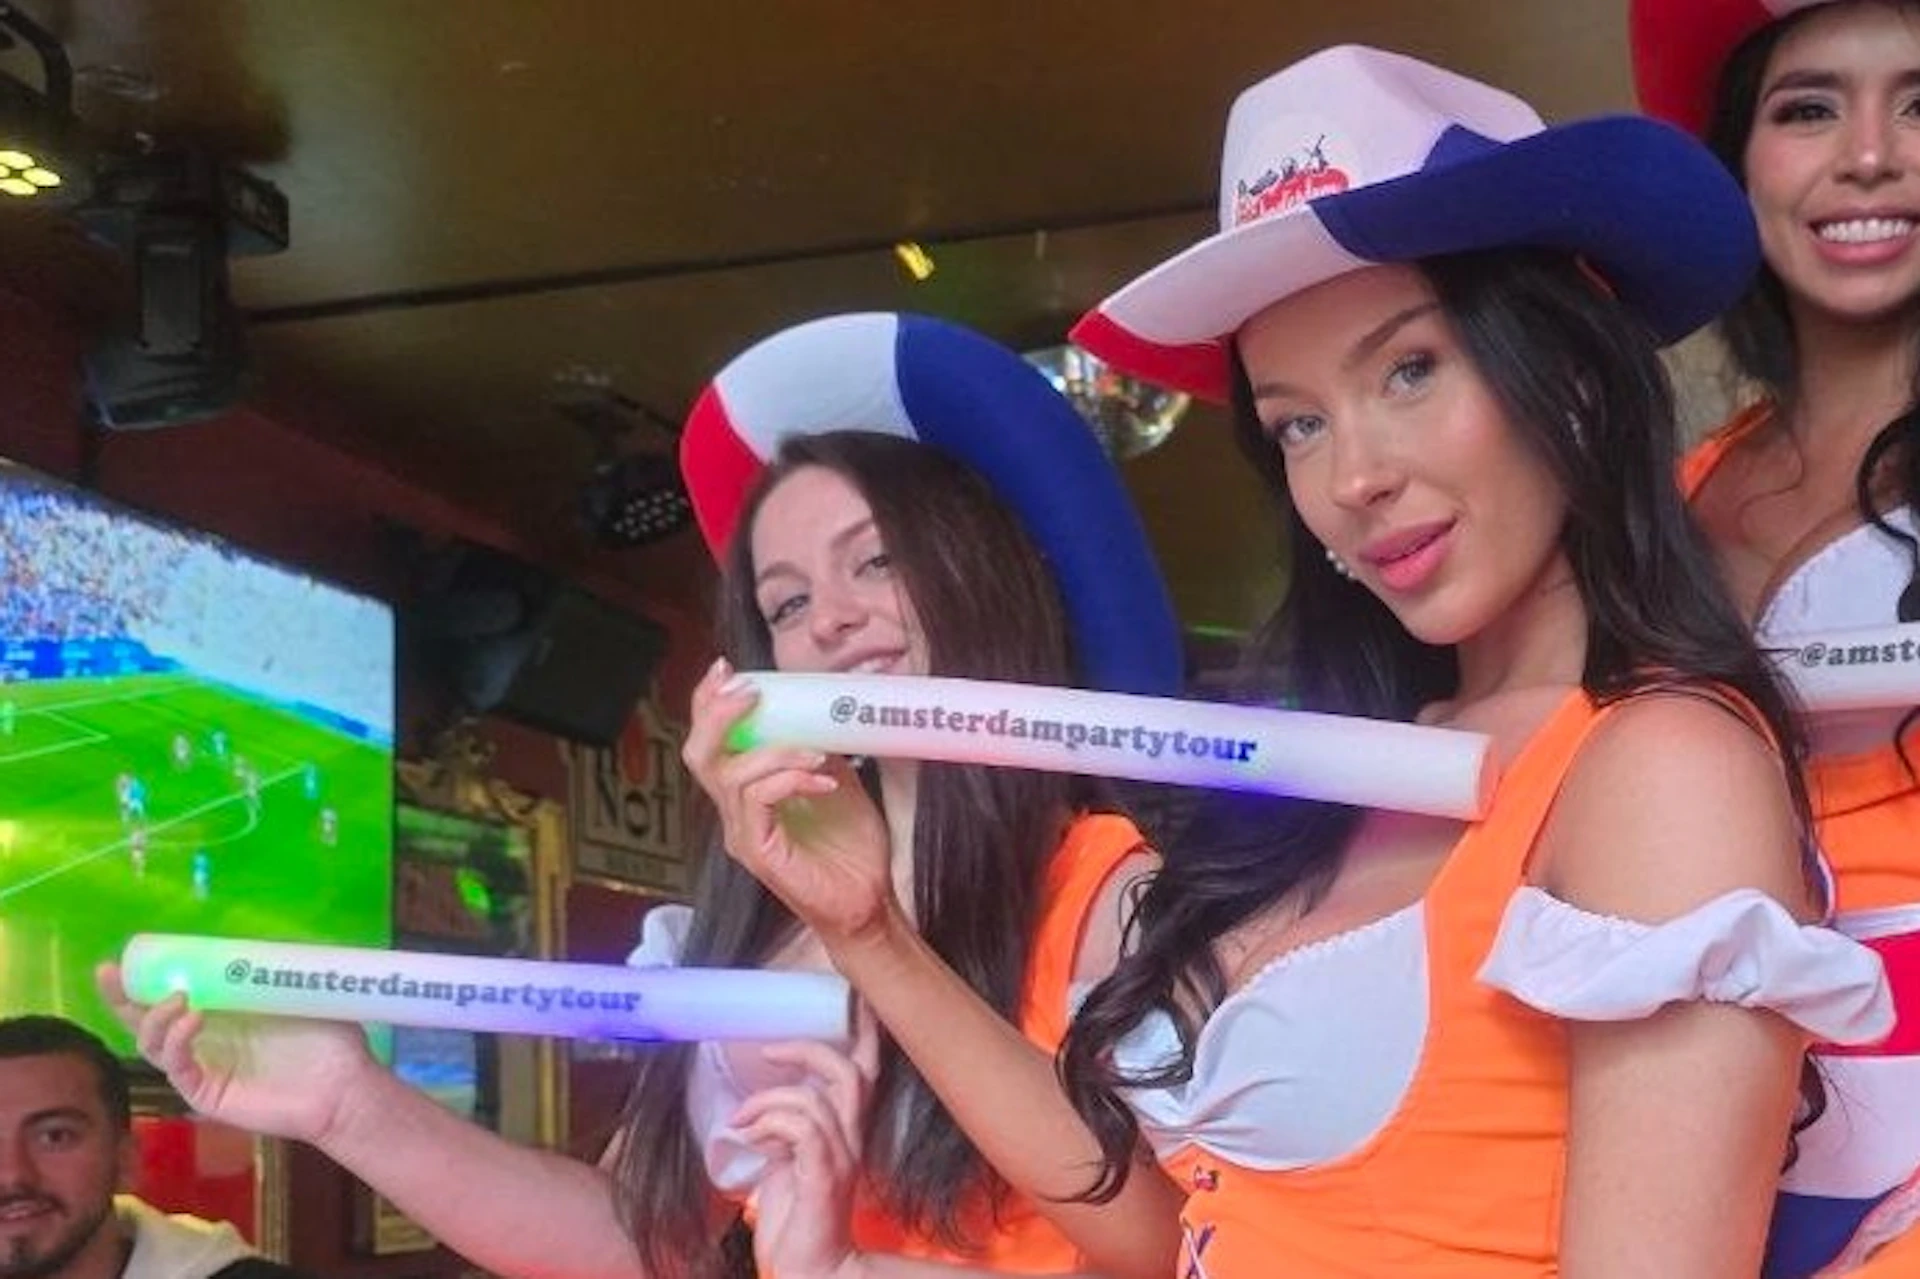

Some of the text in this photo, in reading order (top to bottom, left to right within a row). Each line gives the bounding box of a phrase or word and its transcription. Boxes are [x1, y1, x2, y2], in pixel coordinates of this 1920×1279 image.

[1801, 640, 1920, 668] @amst
[830, 695, 1257, 762] @amsterdampartytour
[224, 959, 641, 1013] @amsterdampartytour
